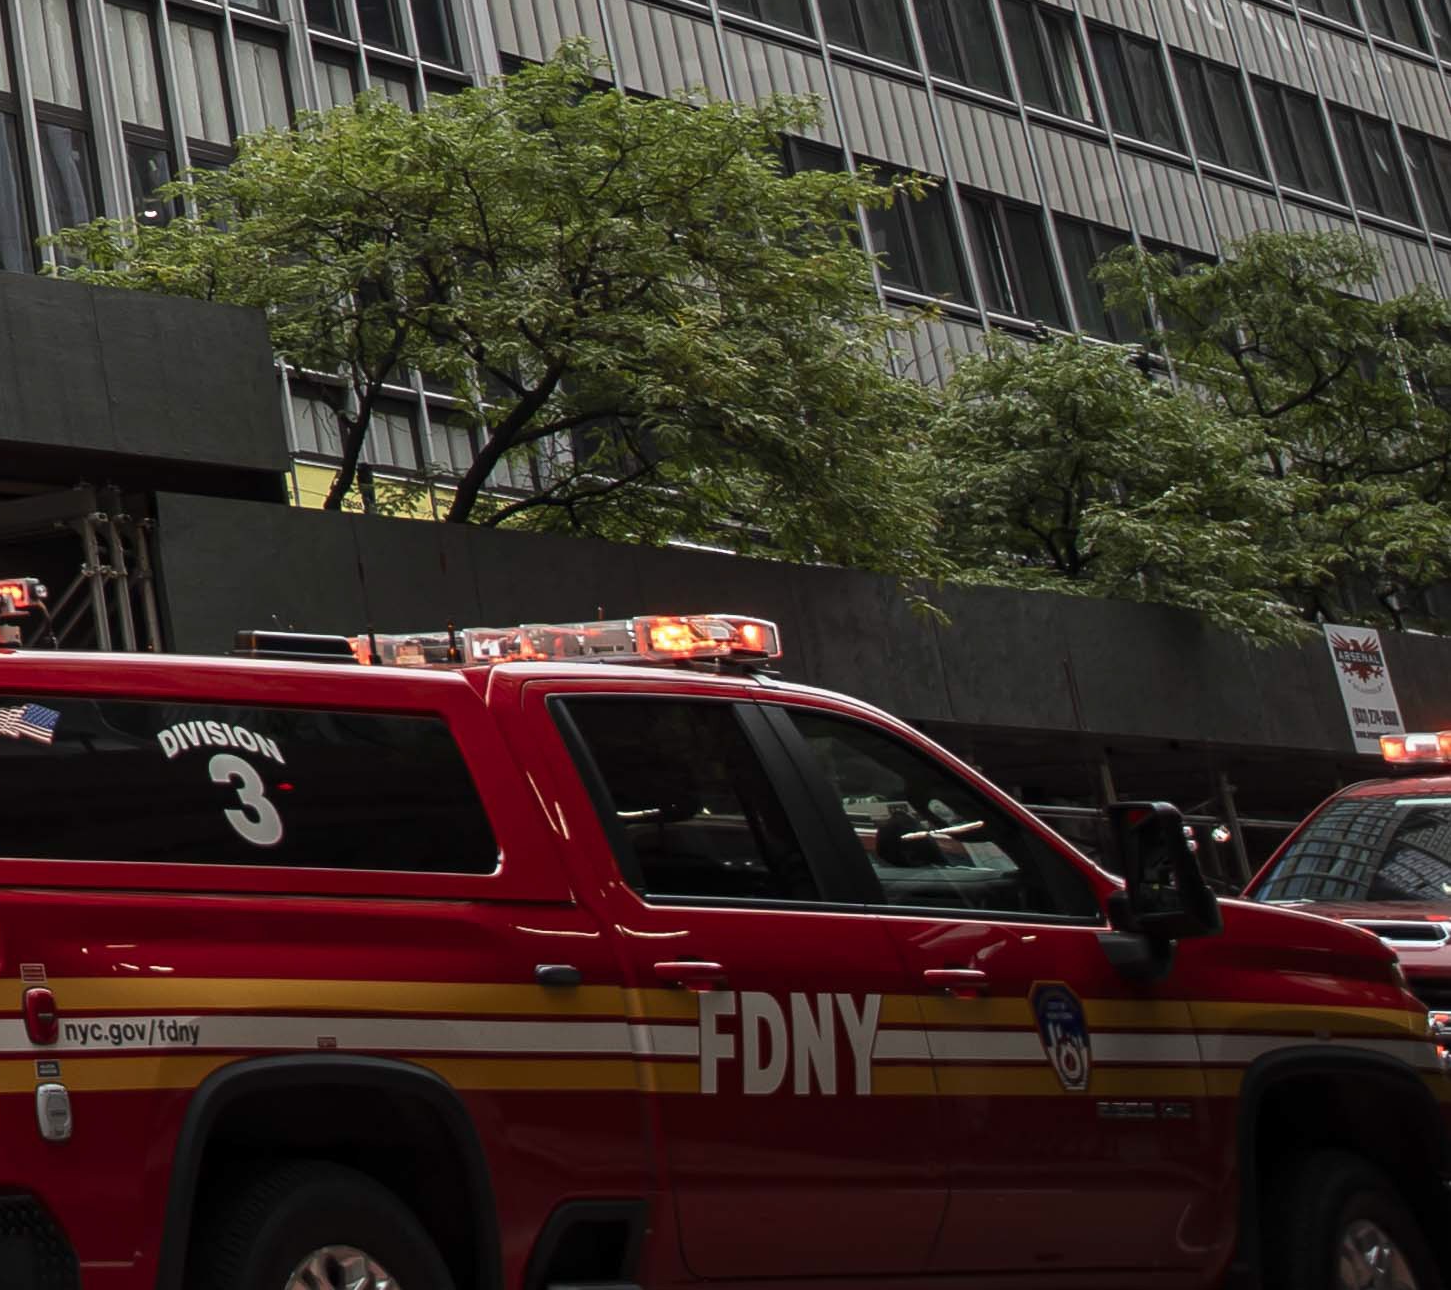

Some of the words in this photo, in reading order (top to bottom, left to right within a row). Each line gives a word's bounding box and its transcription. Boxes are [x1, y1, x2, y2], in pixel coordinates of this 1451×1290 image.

[1338, 651, 1381, 665] ARSENAL
[157, 720, 286, 764] DIVISION
[209, 753, 283, 845] 3
[65, 1018, 200, 1045] nyc.gov/fdny
[699, 990, 882, 1095] FDNY
